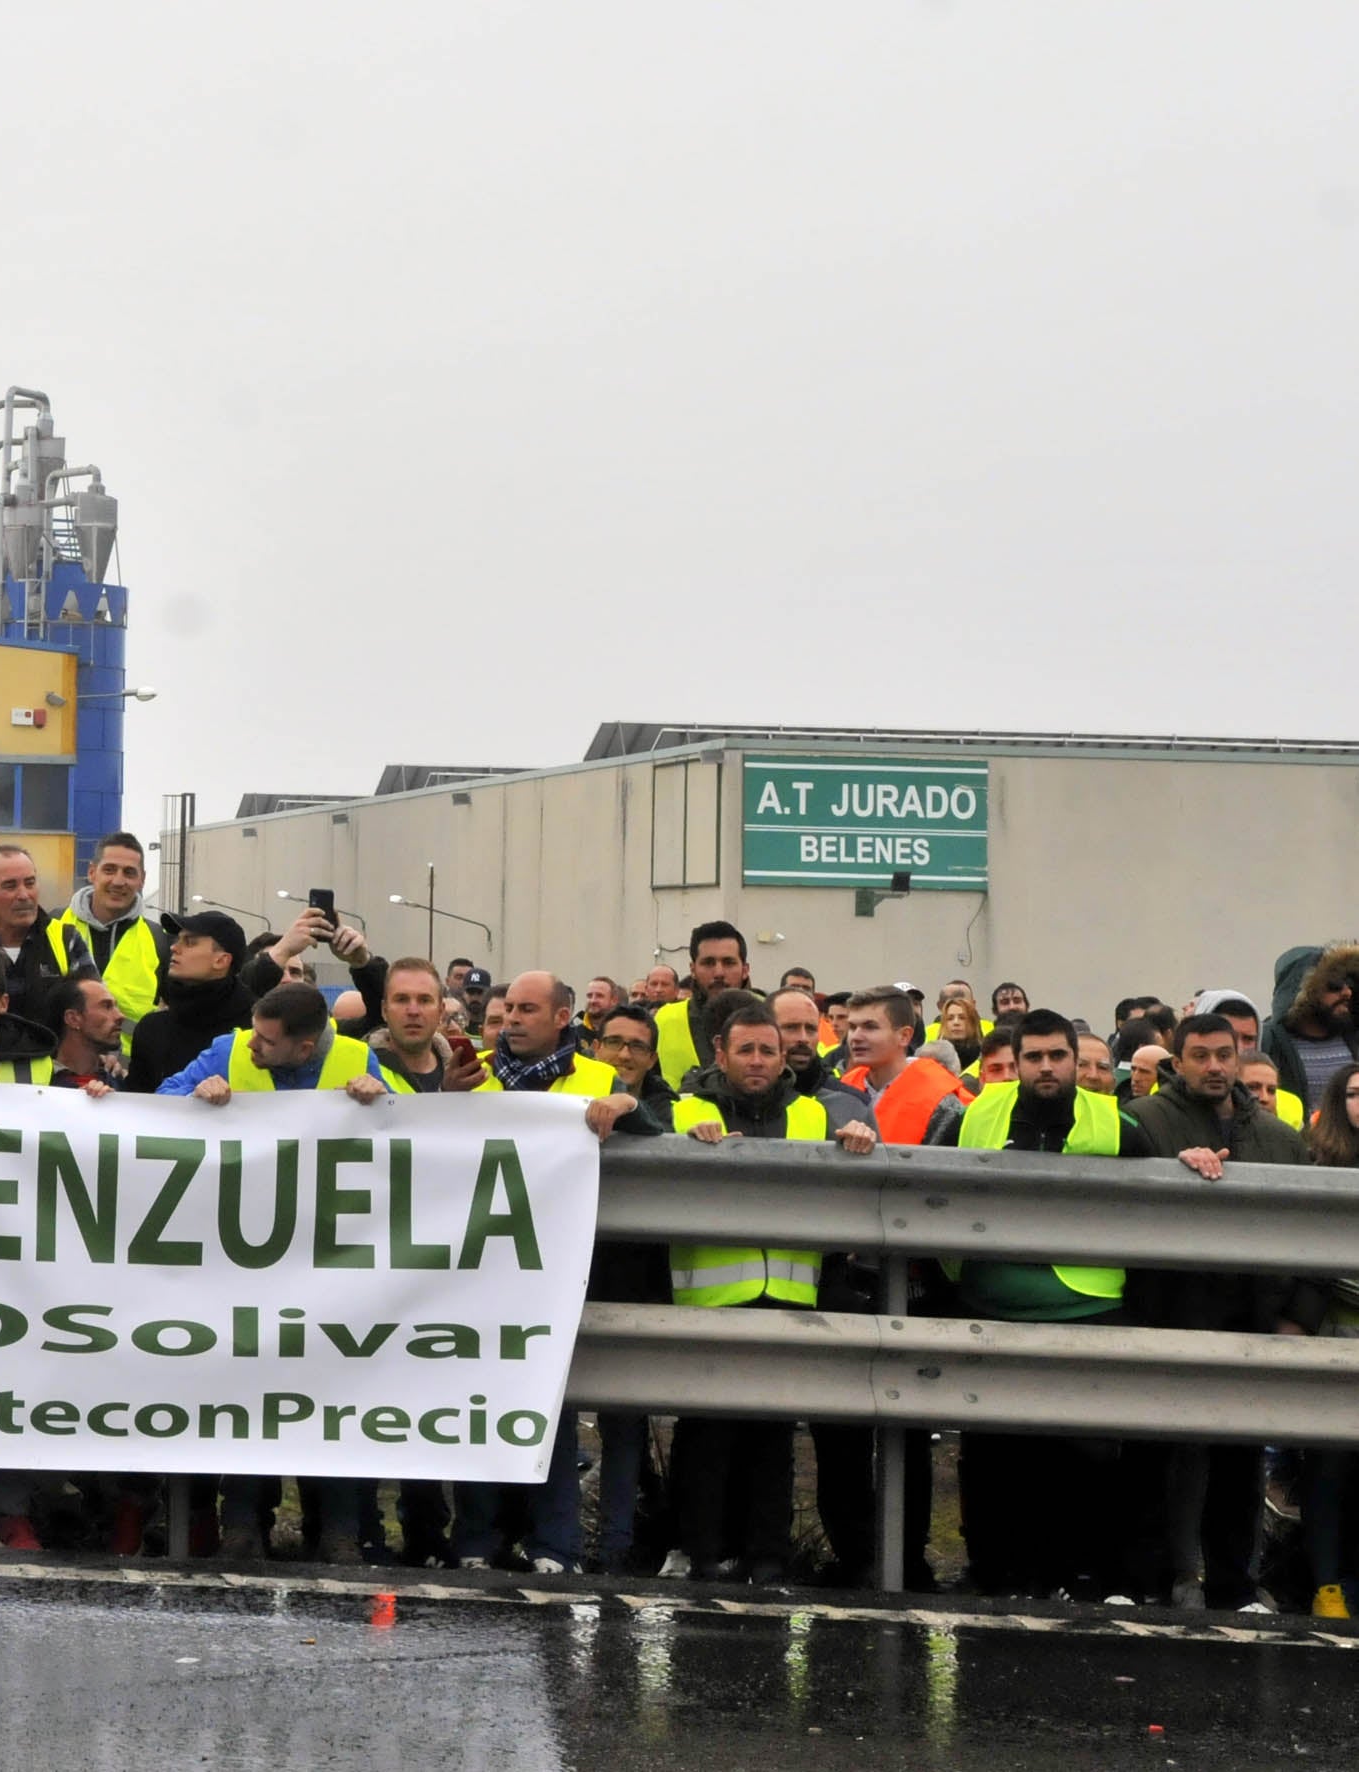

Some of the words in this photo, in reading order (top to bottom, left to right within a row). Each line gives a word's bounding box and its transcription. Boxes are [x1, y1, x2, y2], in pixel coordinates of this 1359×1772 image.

[757, 781, 814, 815] A.T
[831, 783, 977, 820] JURADO
[800, 835, 931, 866] BELENES
